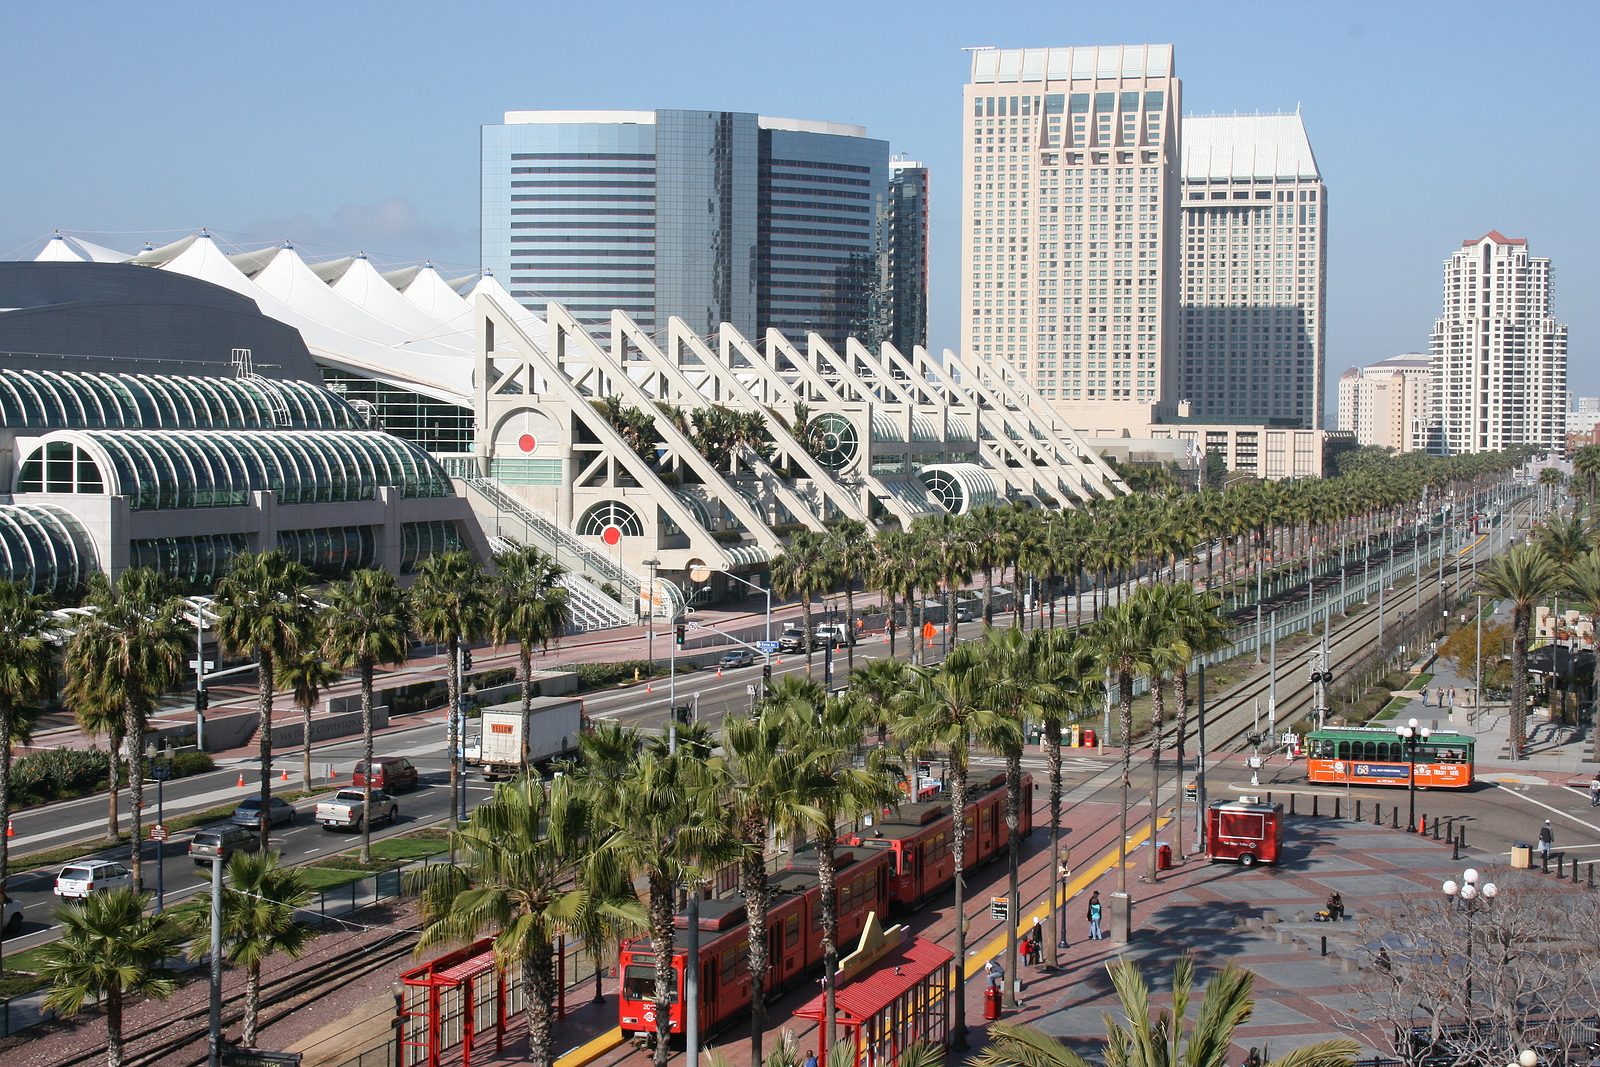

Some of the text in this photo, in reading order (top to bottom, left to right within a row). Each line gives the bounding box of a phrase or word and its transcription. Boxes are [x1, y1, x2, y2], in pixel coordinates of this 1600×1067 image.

[280, 731, 292, 741] SAN
[316, 720, 358, 734] CONVENTION
[492, 724, 512, 733] YELLOW
